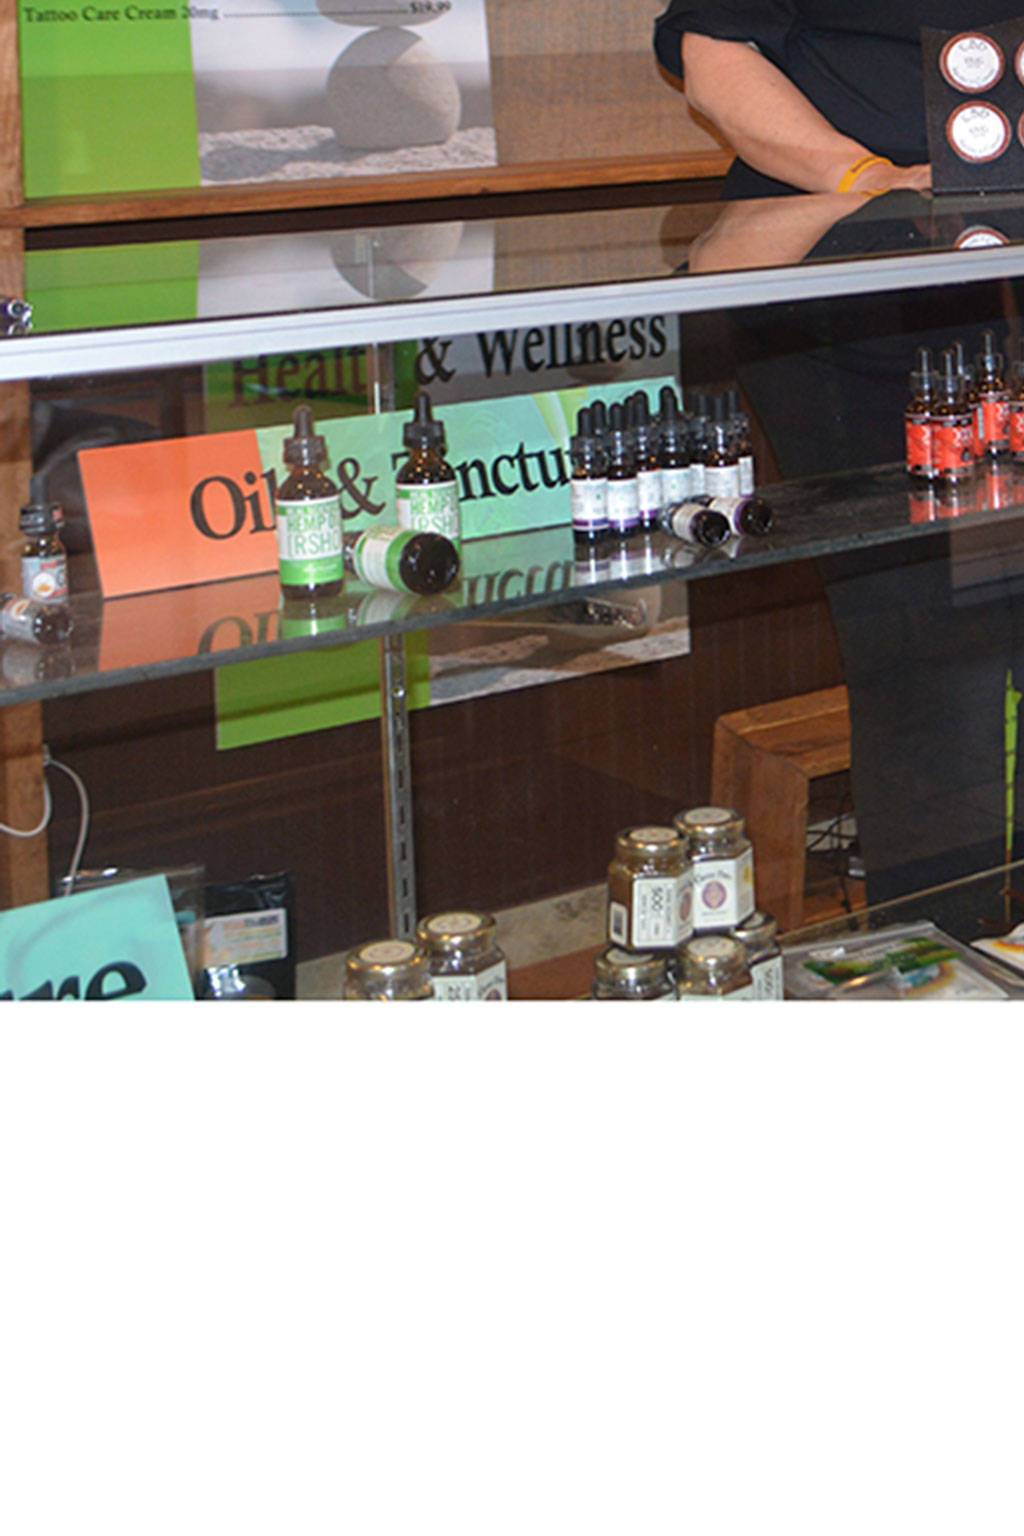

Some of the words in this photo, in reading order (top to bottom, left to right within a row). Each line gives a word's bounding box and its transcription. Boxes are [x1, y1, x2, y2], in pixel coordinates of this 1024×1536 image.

[25, 6, 77, 22] Tattoo
[81, 5, 119, 21] Care
[124, 4, 176, 20] Cream
[229, 348, 367, 407] Healt
[413, 337, 456, 385] &
[478, 315, 666, 378] Wellness
[190, 468, 279, 539] Oil
[337, 458, 386, 520] &
